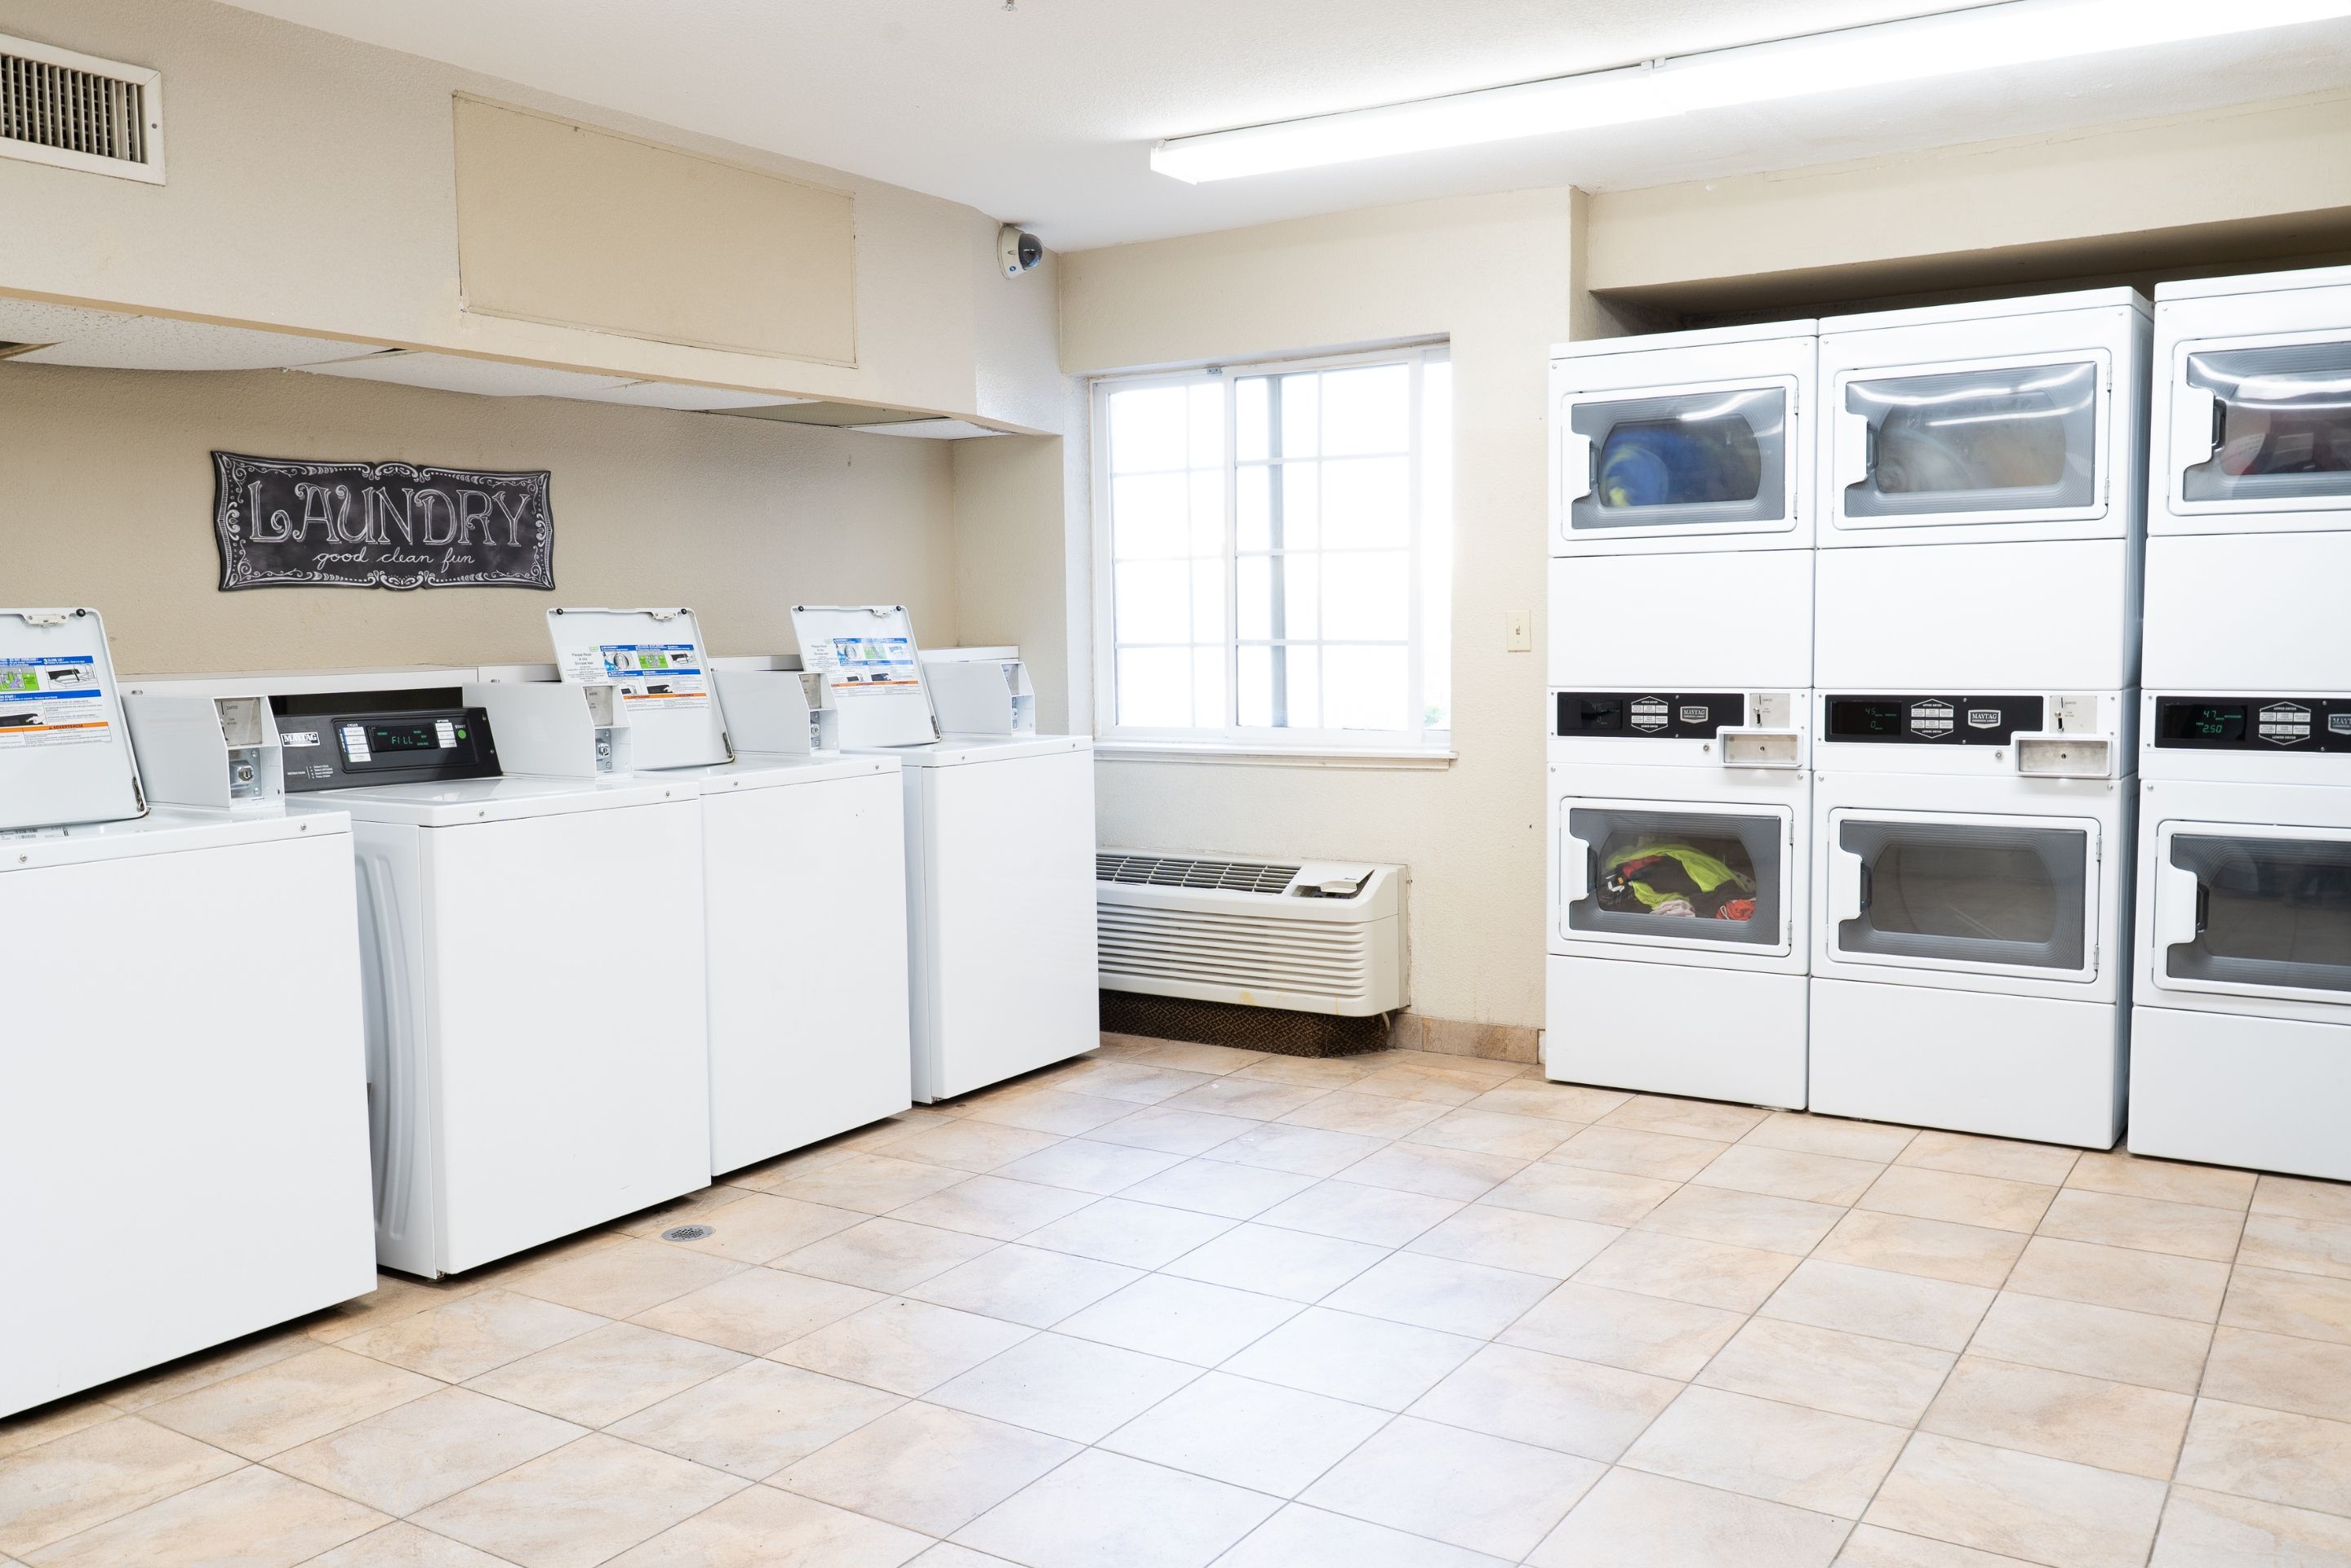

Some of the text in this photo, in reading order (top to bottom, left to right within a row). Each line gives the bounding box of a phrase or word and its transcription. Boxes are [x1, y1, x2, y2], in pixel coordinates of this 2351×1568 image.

[247, 480, 531, 547] LAUNDRY
[312, 546, 474, 573] good clean fun
[2203, 710, 2217, 718] 47
[283, 733, 318, 743] MAYTAG
[392, 736, 413, 744] FILL
